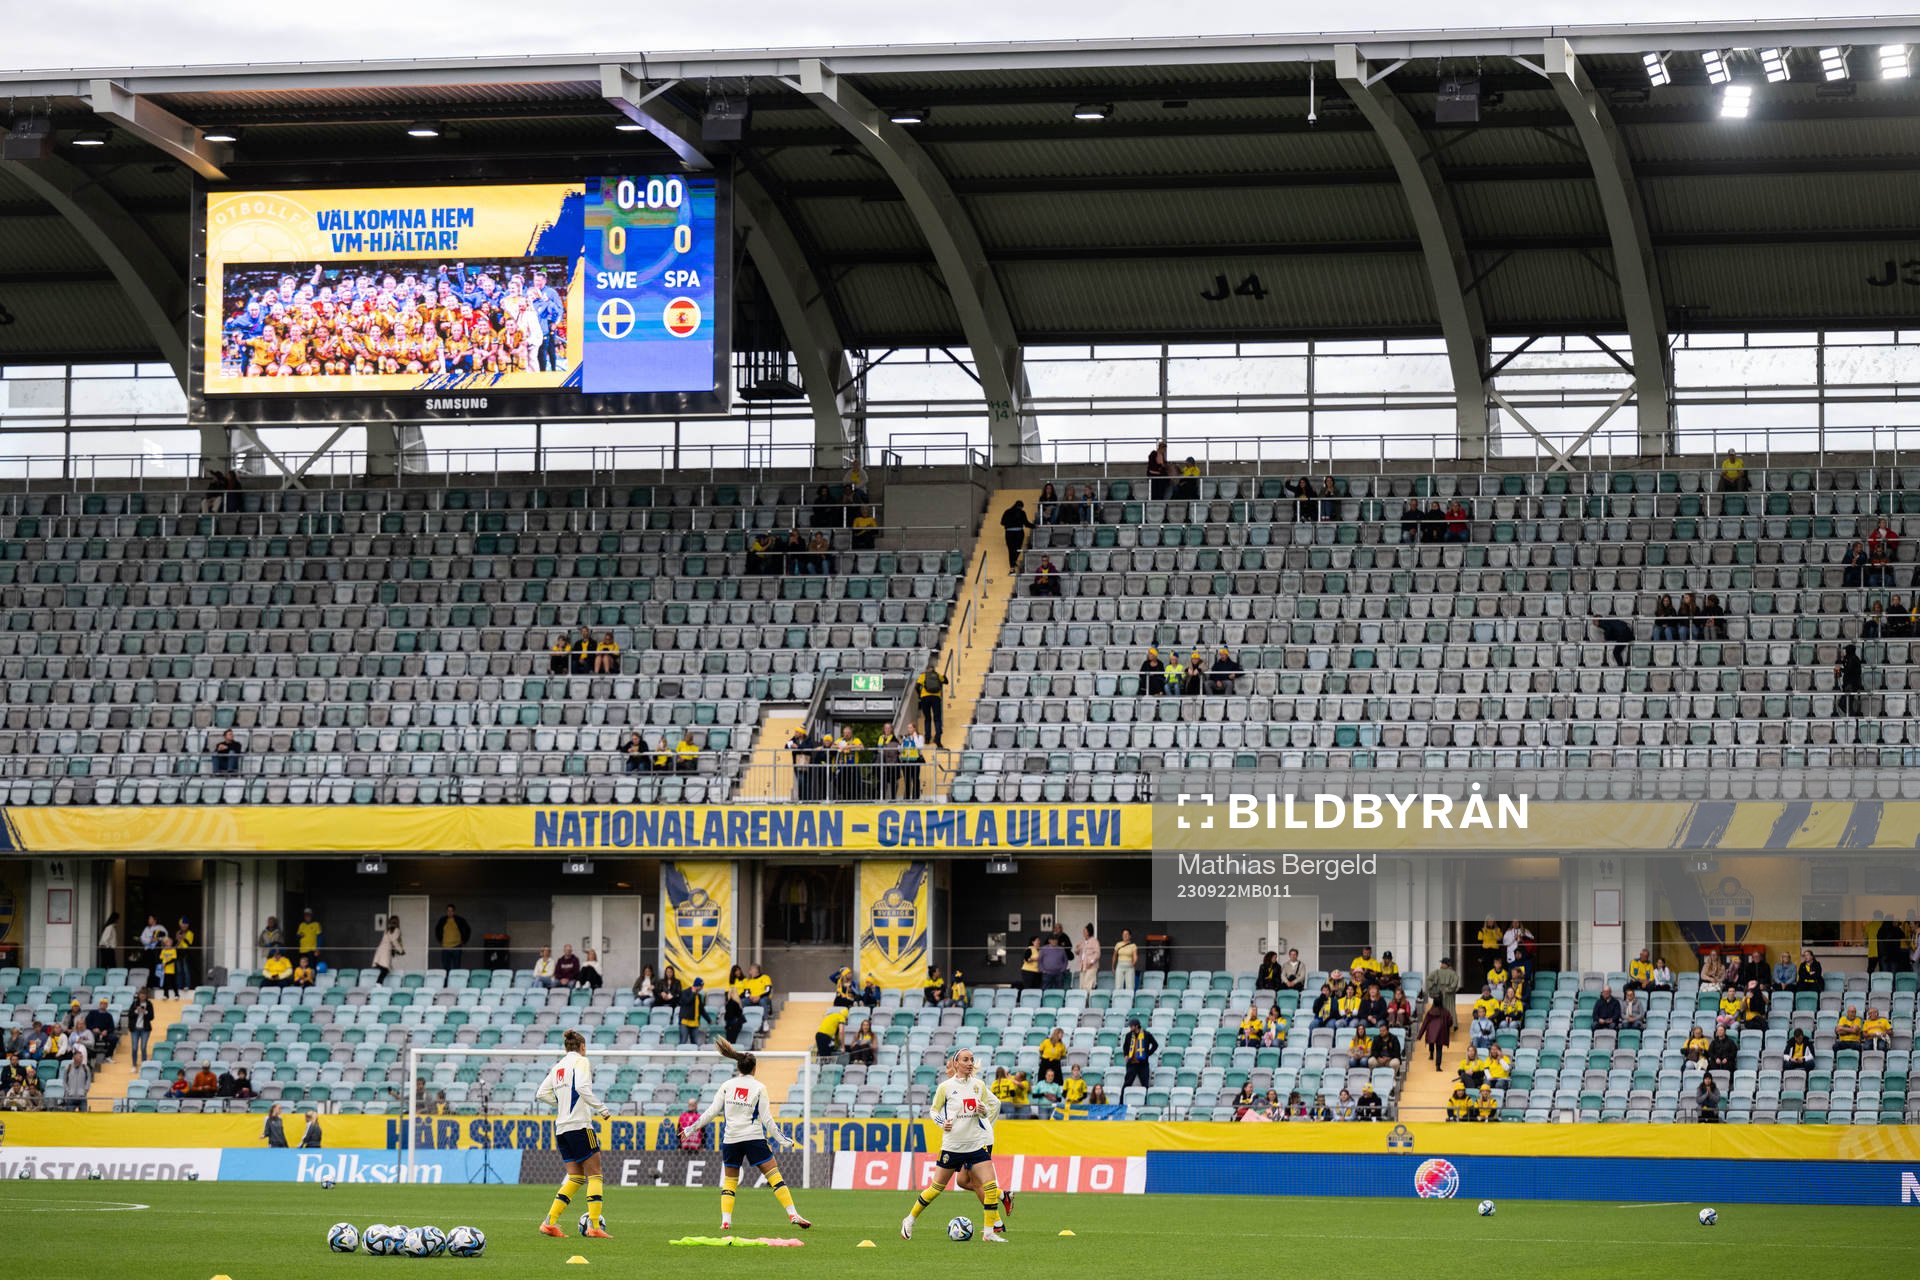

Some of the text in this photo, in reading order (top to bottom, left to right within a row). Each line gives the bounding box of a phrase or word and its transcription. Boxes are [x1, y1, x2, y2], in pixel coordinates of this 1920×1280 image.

[618, 179, 682, 209] 0:00
[317, 208, 474, 231] VÄLKOMNA HEM
[331, 230, 459, 252] VM-HJÄLTAR!
[609, 225, 692, 255] 0 0
[596, 270, 701, 289] SWE SPA
[1200, 274, 1268, 300] J4
[425, 398, 488, 410] SAMSUNG
[534, 809, 843, 847] NATIONALARENAN
[878, 810, 998, 846] GAMLA
[1007, 809, 1121, 846] ULLEVI
[387, 1116, 460, 1150] HÄR
[296, 1153, 443, 1184] Folksam
[864, 1160, 1115, 1190] CRMO
